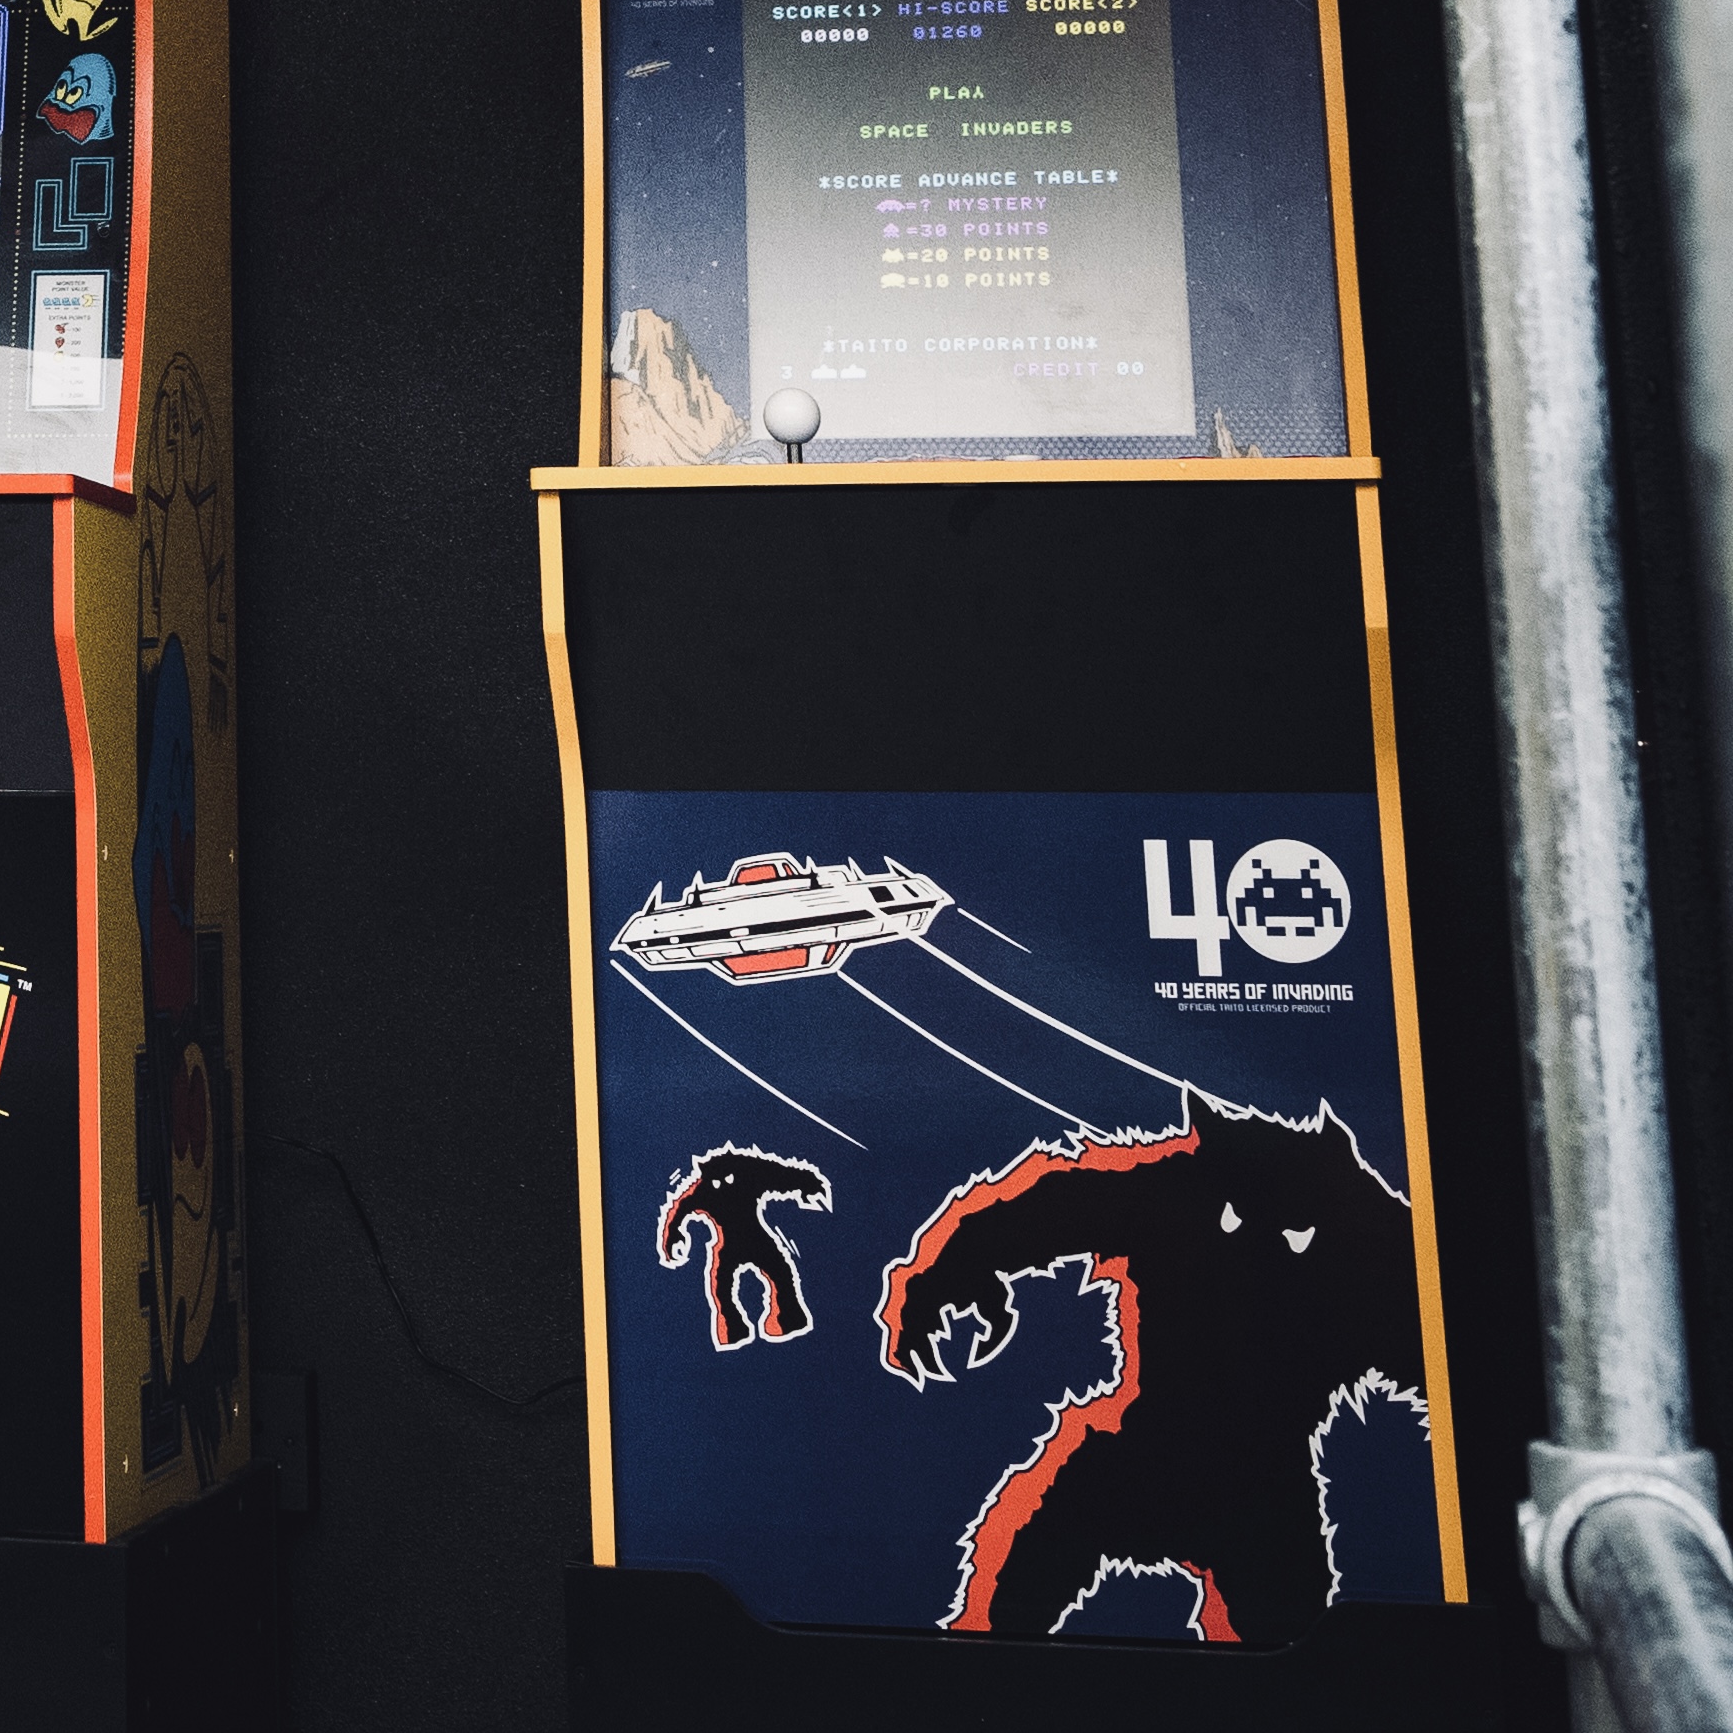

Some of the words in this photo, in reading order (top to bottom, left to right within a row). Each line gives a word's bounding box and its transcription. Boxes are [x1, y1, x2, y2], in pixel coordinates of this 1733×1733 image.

[897, 0, 1010, 17] HI-SCORE
[800, 27, 870, 44] 00000
[912, 24, 984, 40] 01260
[1054, 20, 1126, 36] 00000
[859, 123, 929, 140] SPACE
[960, 120, 1074, 137] INVADERS
[918, 171, 1018, 188] ADVANCE
[948, 196, 1049, 212] MYSTERY
[963, 221, 1050, 237] POINTS
[964, 246, 1051, 263] POINTS
[965, 272, 1052, 289] POINTS
[1012, 362, 1100, 378] CREDIT
[1116, 361, 1146, 377] 00
[1154, 982, 1179, 1000] 40
[1181, 982, 1241, 1001] YEARS
[1244, 983, 1269, 1001] OF
[1271, 983, 1354, 1002] INVADING
[1178, 1002, 1217, 1012] OFFICIAL
[1219, 1003, 1244, 1013] TAITO
[1246, 1003, 1290, 1014] LICENSED
[1291, 1004, 1332, 1014] PRODUCT
